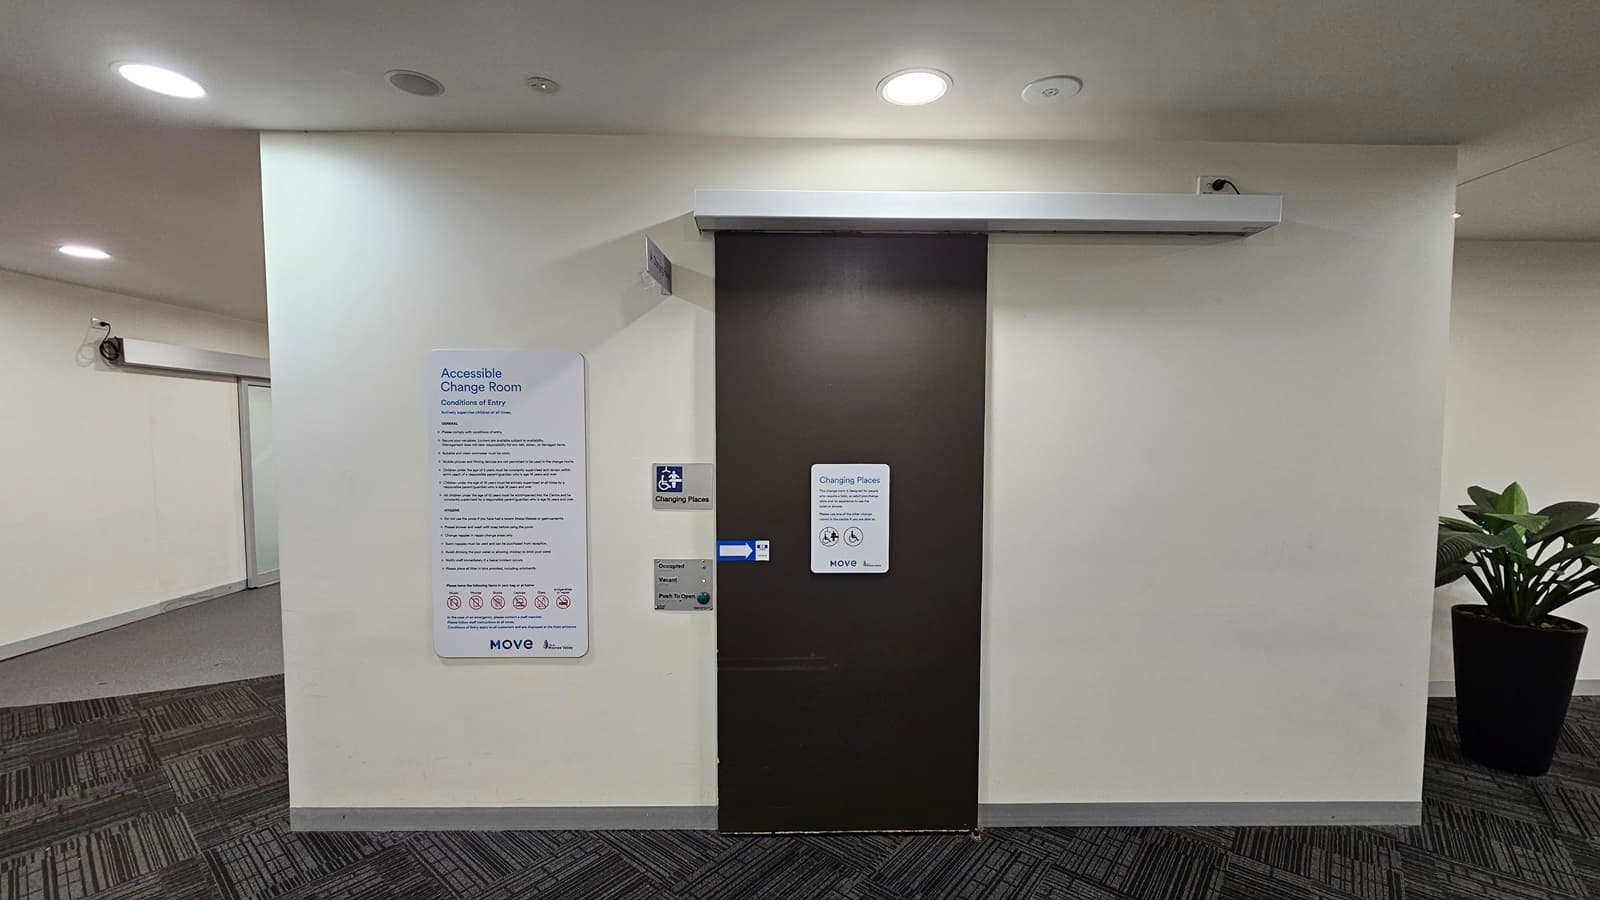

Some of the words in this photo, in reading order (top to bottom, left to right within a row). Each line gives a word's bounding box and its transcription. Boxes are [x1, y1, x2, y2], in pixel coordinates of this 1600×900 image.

[441, 368, 502, 378] Accessible
[441, 382, 485, 394] Change
[489, 382, 521, 392] Room
[819, 476, 855, 485] Changing
